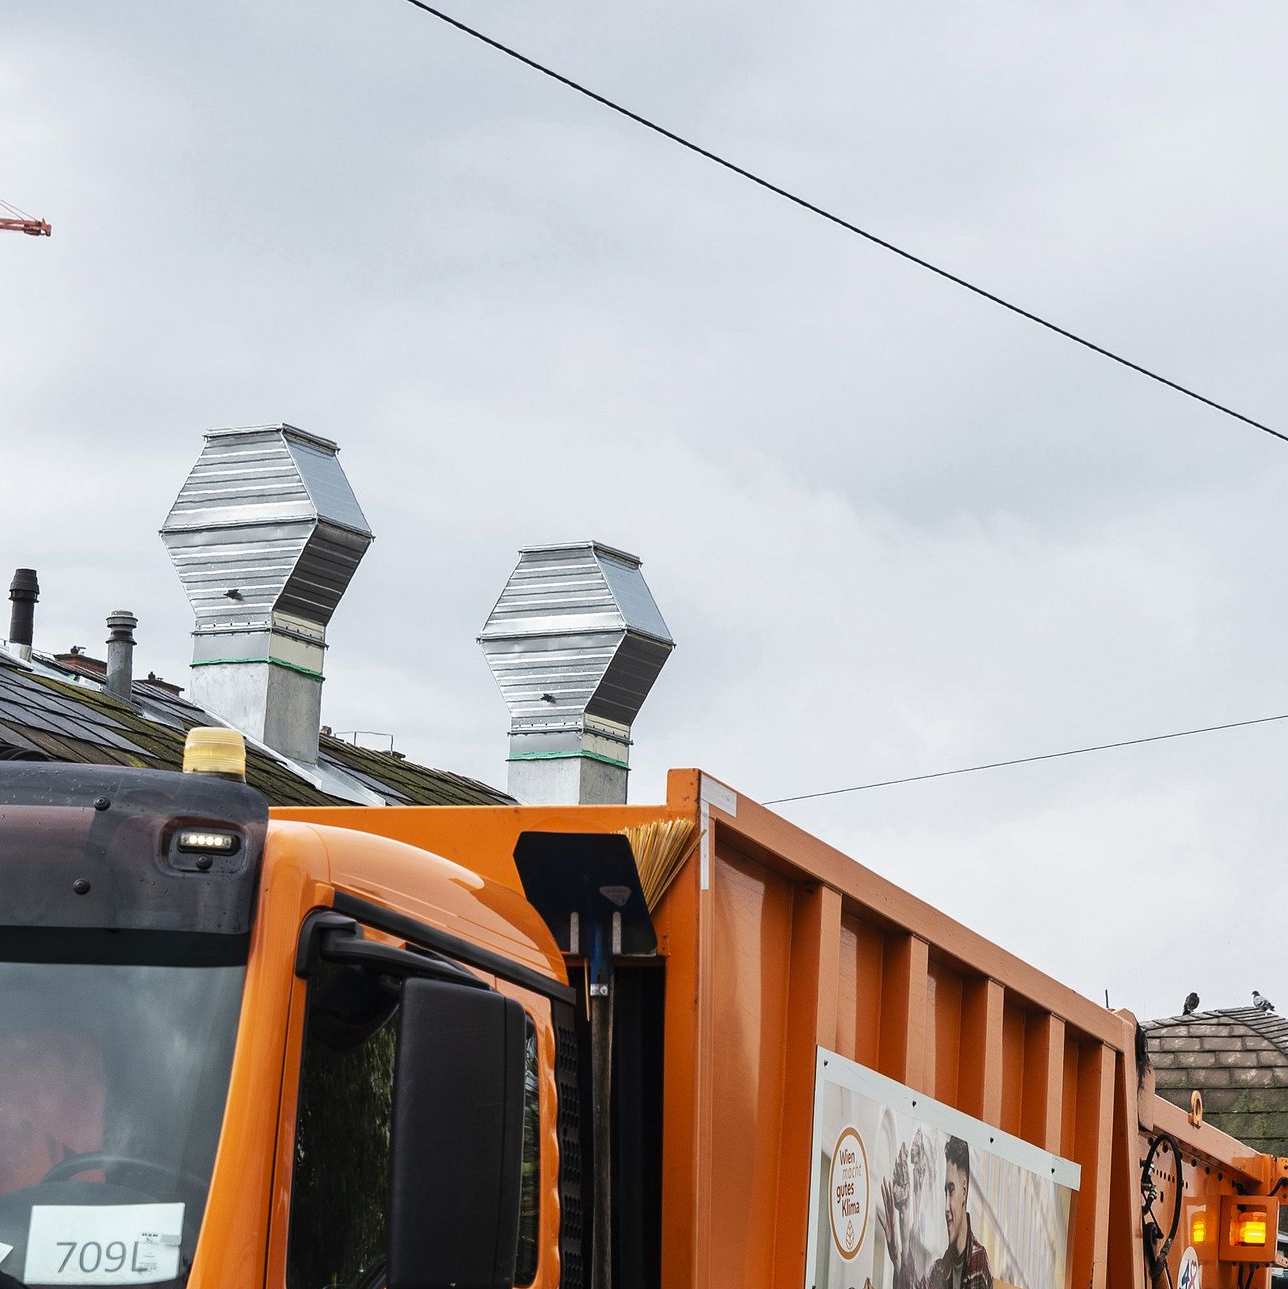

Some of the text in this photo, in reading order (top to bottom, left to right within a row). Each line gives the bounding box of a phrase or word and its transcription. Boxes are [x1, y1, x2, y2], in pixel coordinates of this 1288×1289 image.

[840, 1149, 855, 1165] Wien
[837, 1181, 855, 1203] gutes
[841, 1199, 860, 1217] Klima
